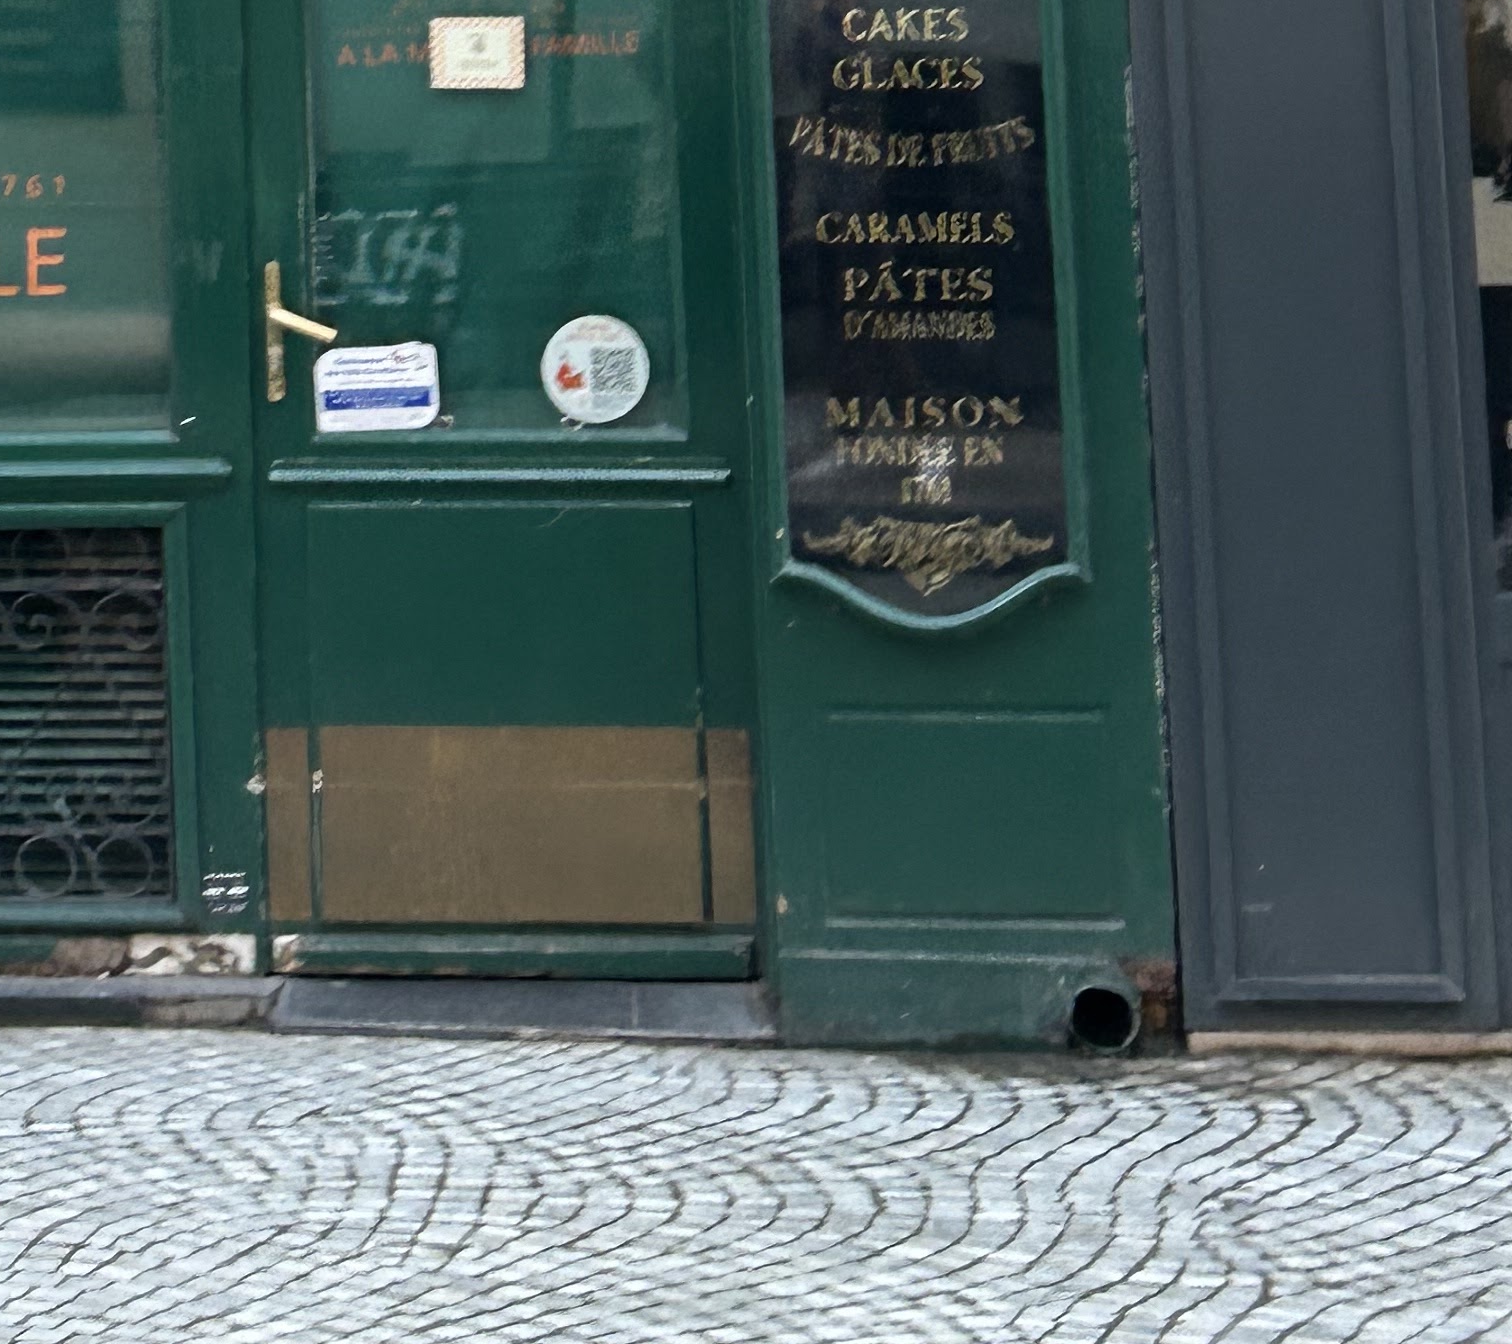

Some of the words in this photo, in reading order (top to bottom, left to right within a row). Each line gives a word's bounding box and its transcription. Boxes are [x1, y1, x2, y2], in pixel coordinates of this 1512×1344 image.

[841, 7, 970, 43] CAKES
[831, 56, 985, 92] GLACES
[815, 211, 1017, 245] CARAMELS
[843, 259, 994, 303] PÂTES
[824, 395, 1025, 429] MAISON
